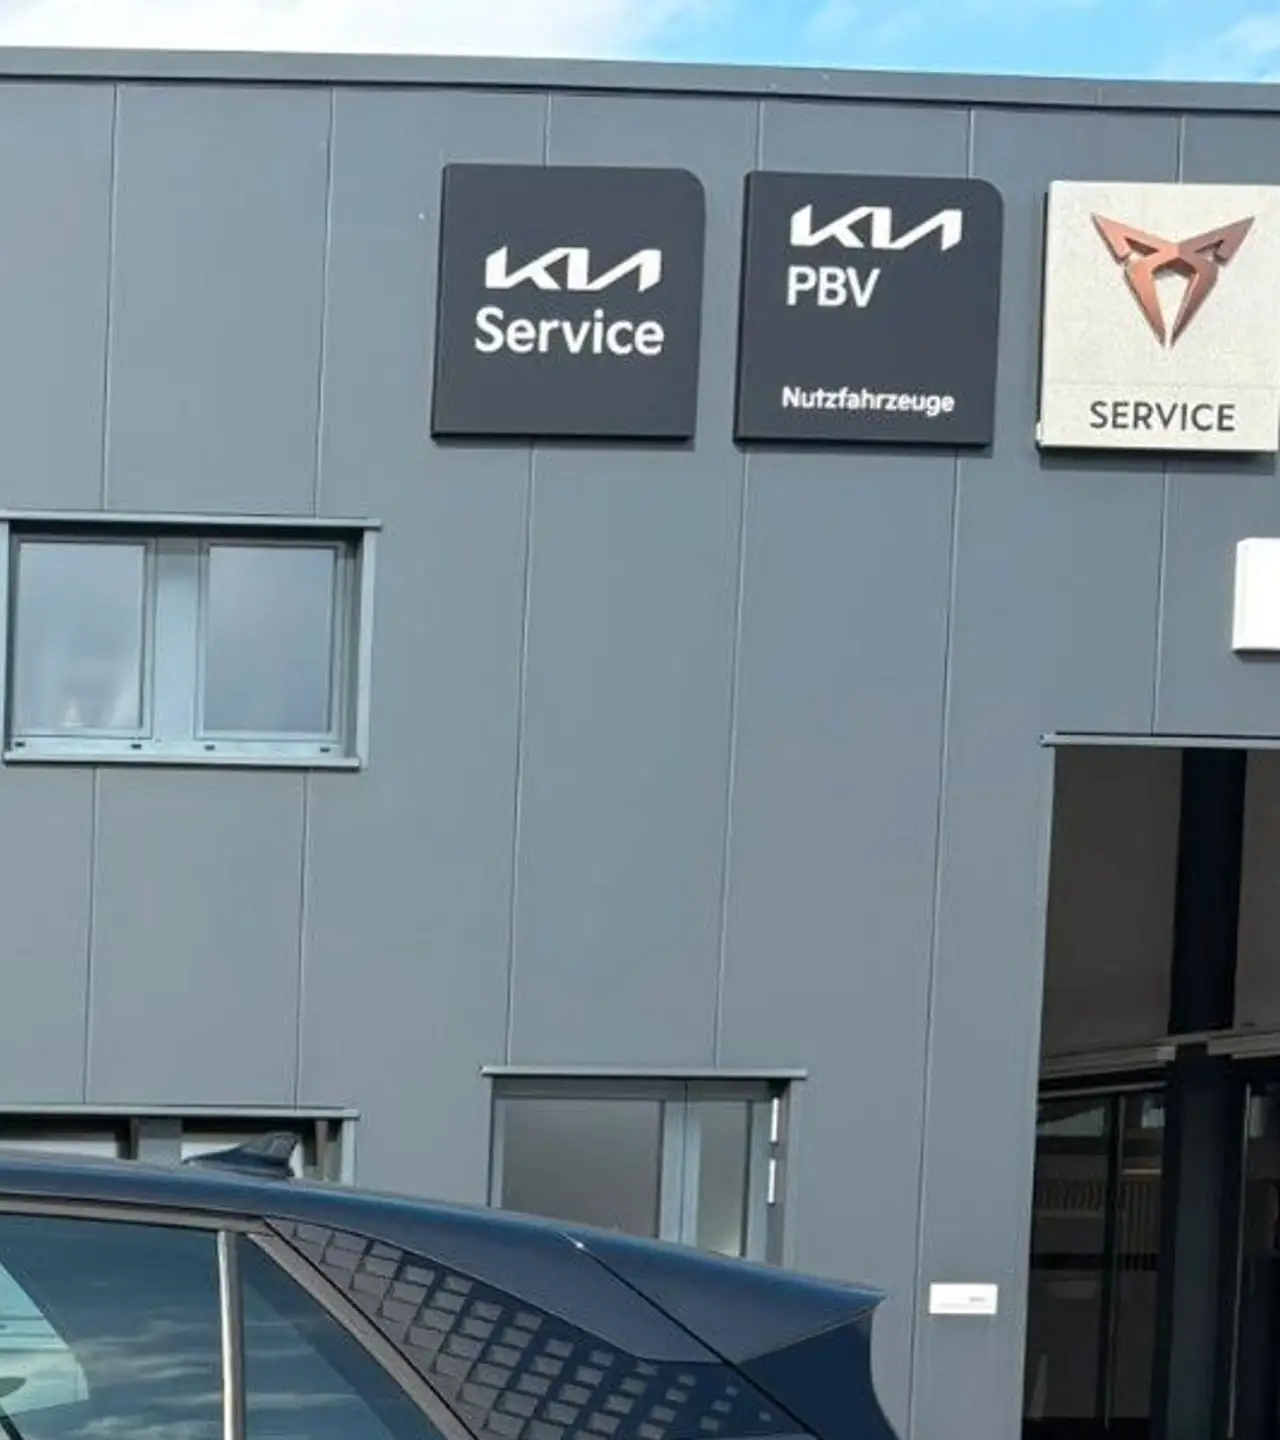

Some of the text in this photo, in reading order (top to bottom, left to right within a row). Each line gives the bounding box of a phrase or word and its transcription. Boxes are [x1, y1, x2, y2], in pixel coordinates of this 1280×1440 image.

[787, 265, 881, 308] PBV
[474, 305, 665, 355] Service
[781, 386, 955, 417] Nutzfahrzeuge
[1089, 400, 1236, 432] SERVICE
